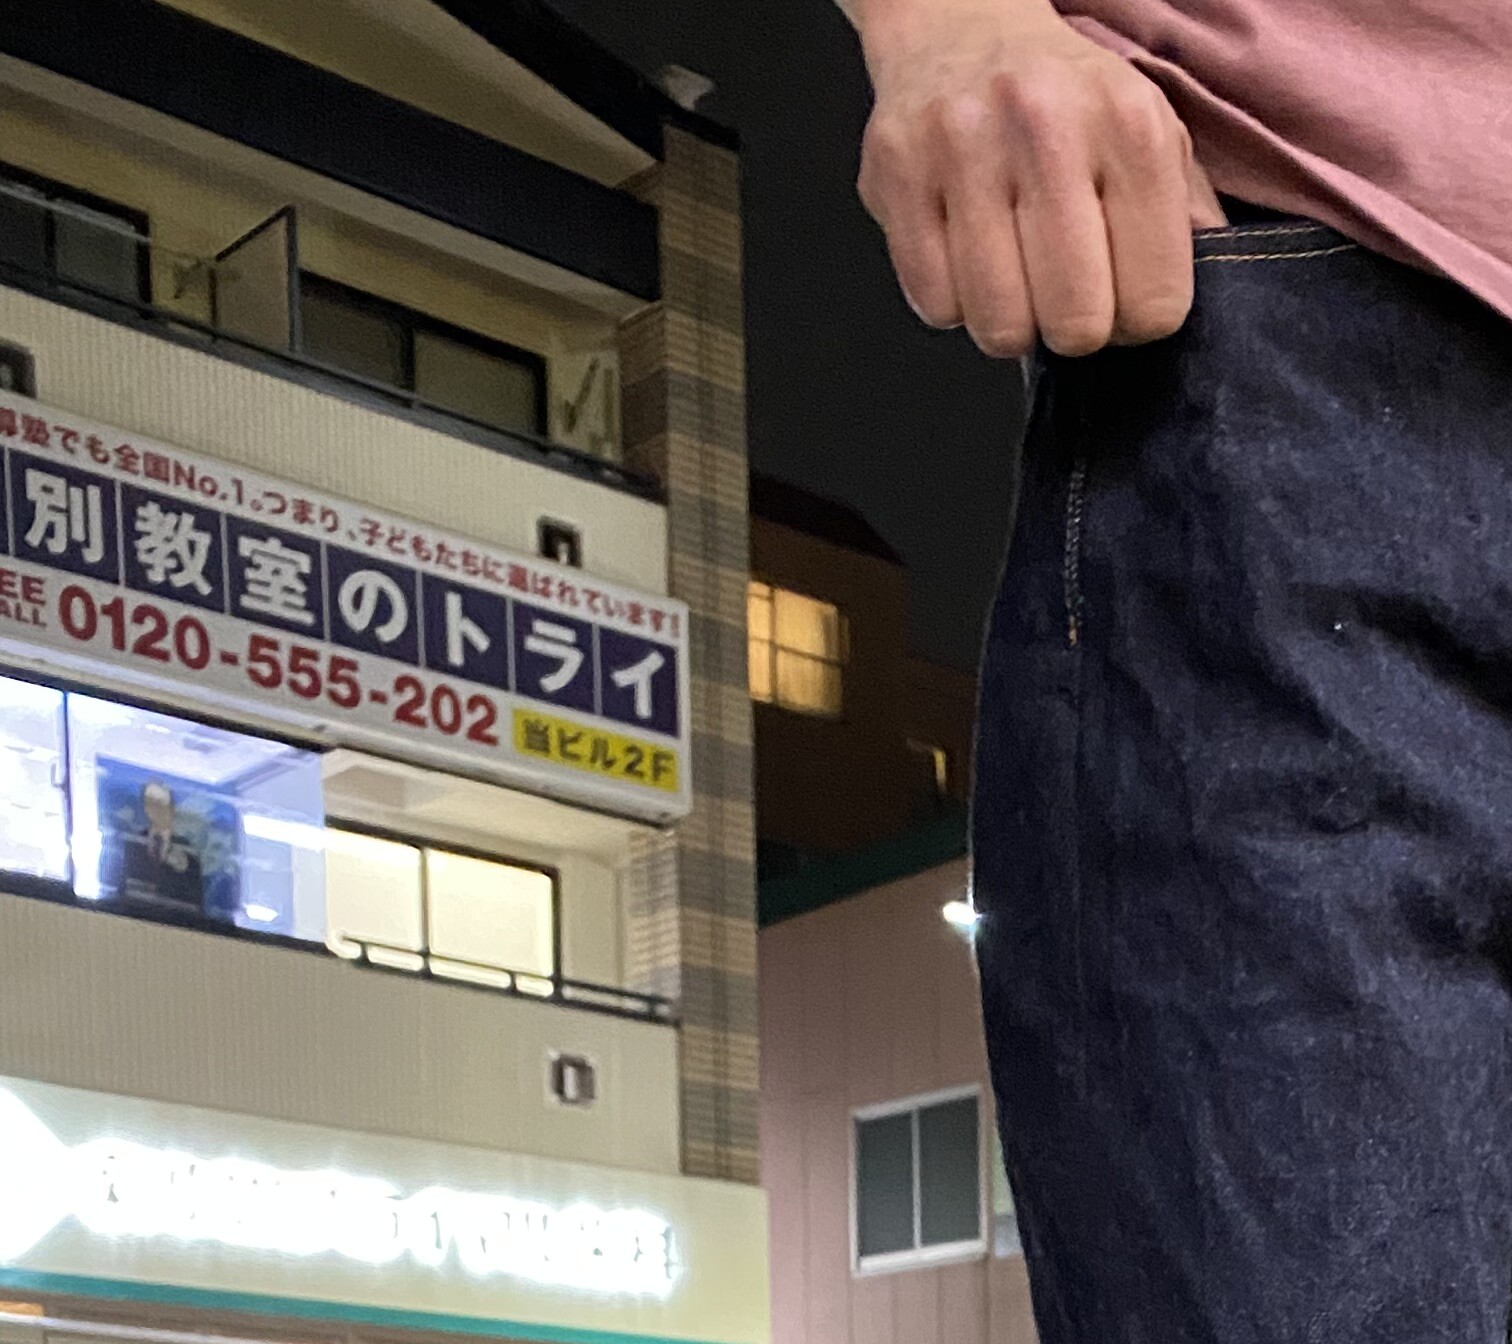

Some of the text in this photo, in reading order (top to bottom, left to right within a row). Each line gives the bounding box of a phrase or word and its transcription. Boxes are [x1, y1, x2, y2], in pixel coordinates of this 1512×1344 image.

[24, 467, 665, 719] 別教室のトライ
[58, 584, 498, 746] 0120-555-202
[522, 718, 675, 783] 当ビル2F
